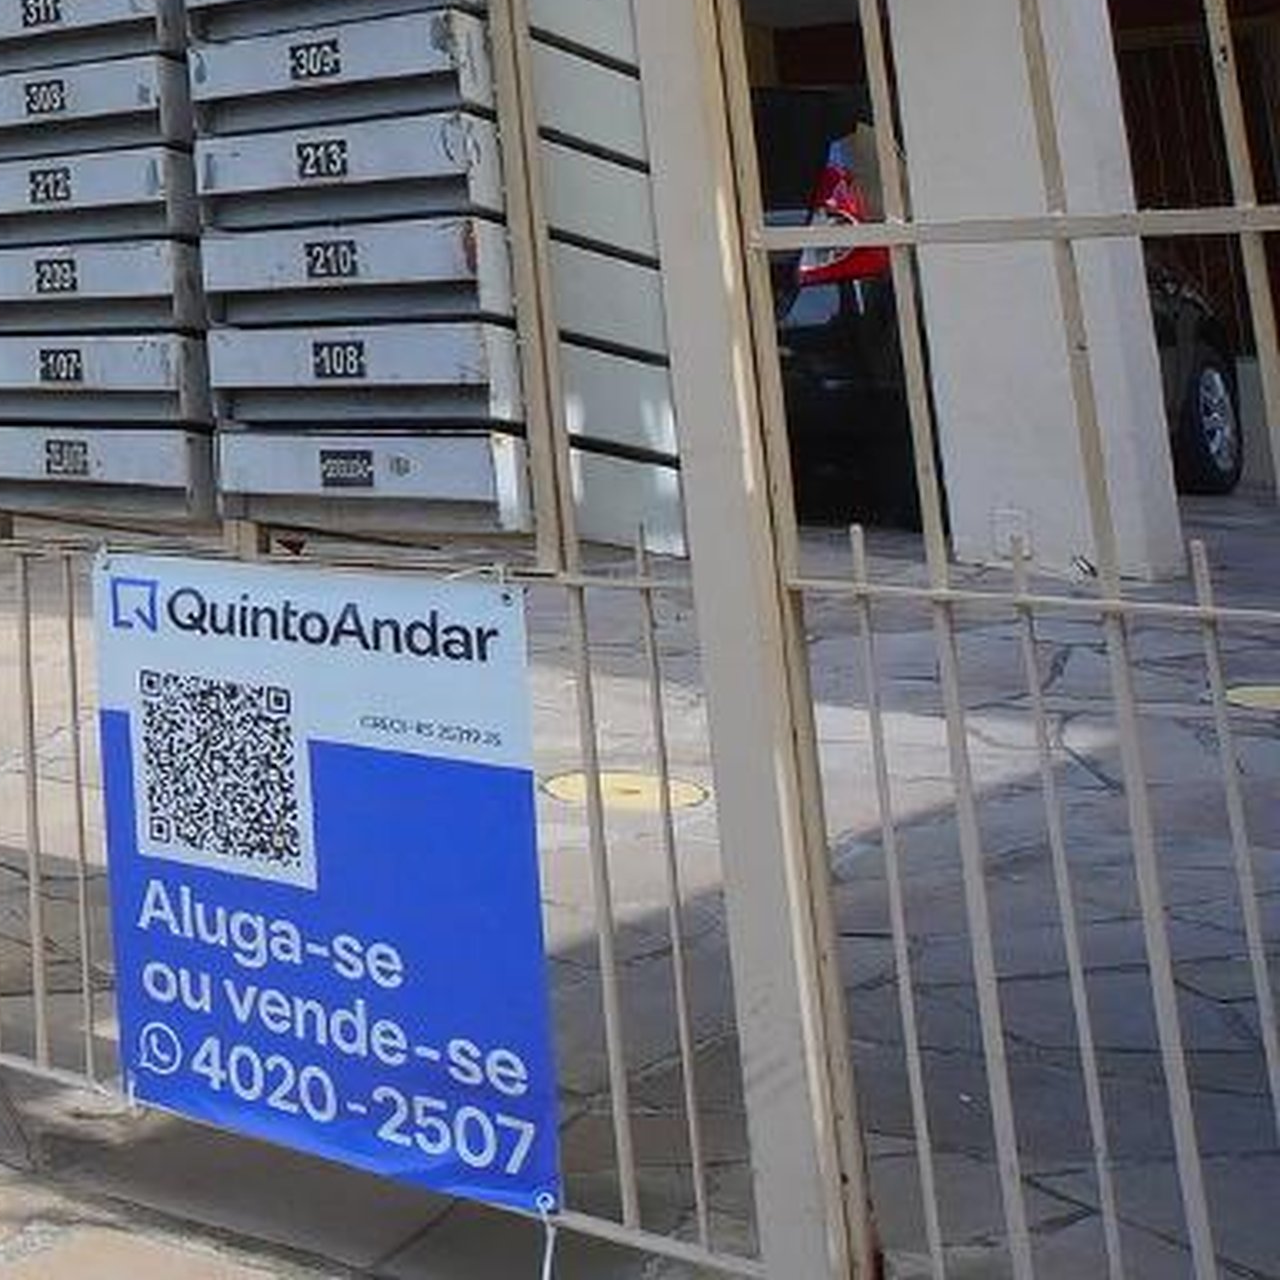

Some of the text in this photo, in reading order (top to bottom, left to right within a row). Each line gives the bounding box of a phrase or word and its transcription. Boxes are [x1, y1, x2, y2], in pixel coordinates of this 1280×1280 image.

[302, 142, 342, 177] 213
[310, 242, 352, 275] 210
[44, 352, 79, 378] 107
[318, 343, 361, 375] 108
[167, 588, 500, 664] QuintoAndar
[136, 880, 405, 988] Aluga-se
[142, 957, 531, 1097] ou vende-se
[191, 1036, 538, 1176] 4020-2507
